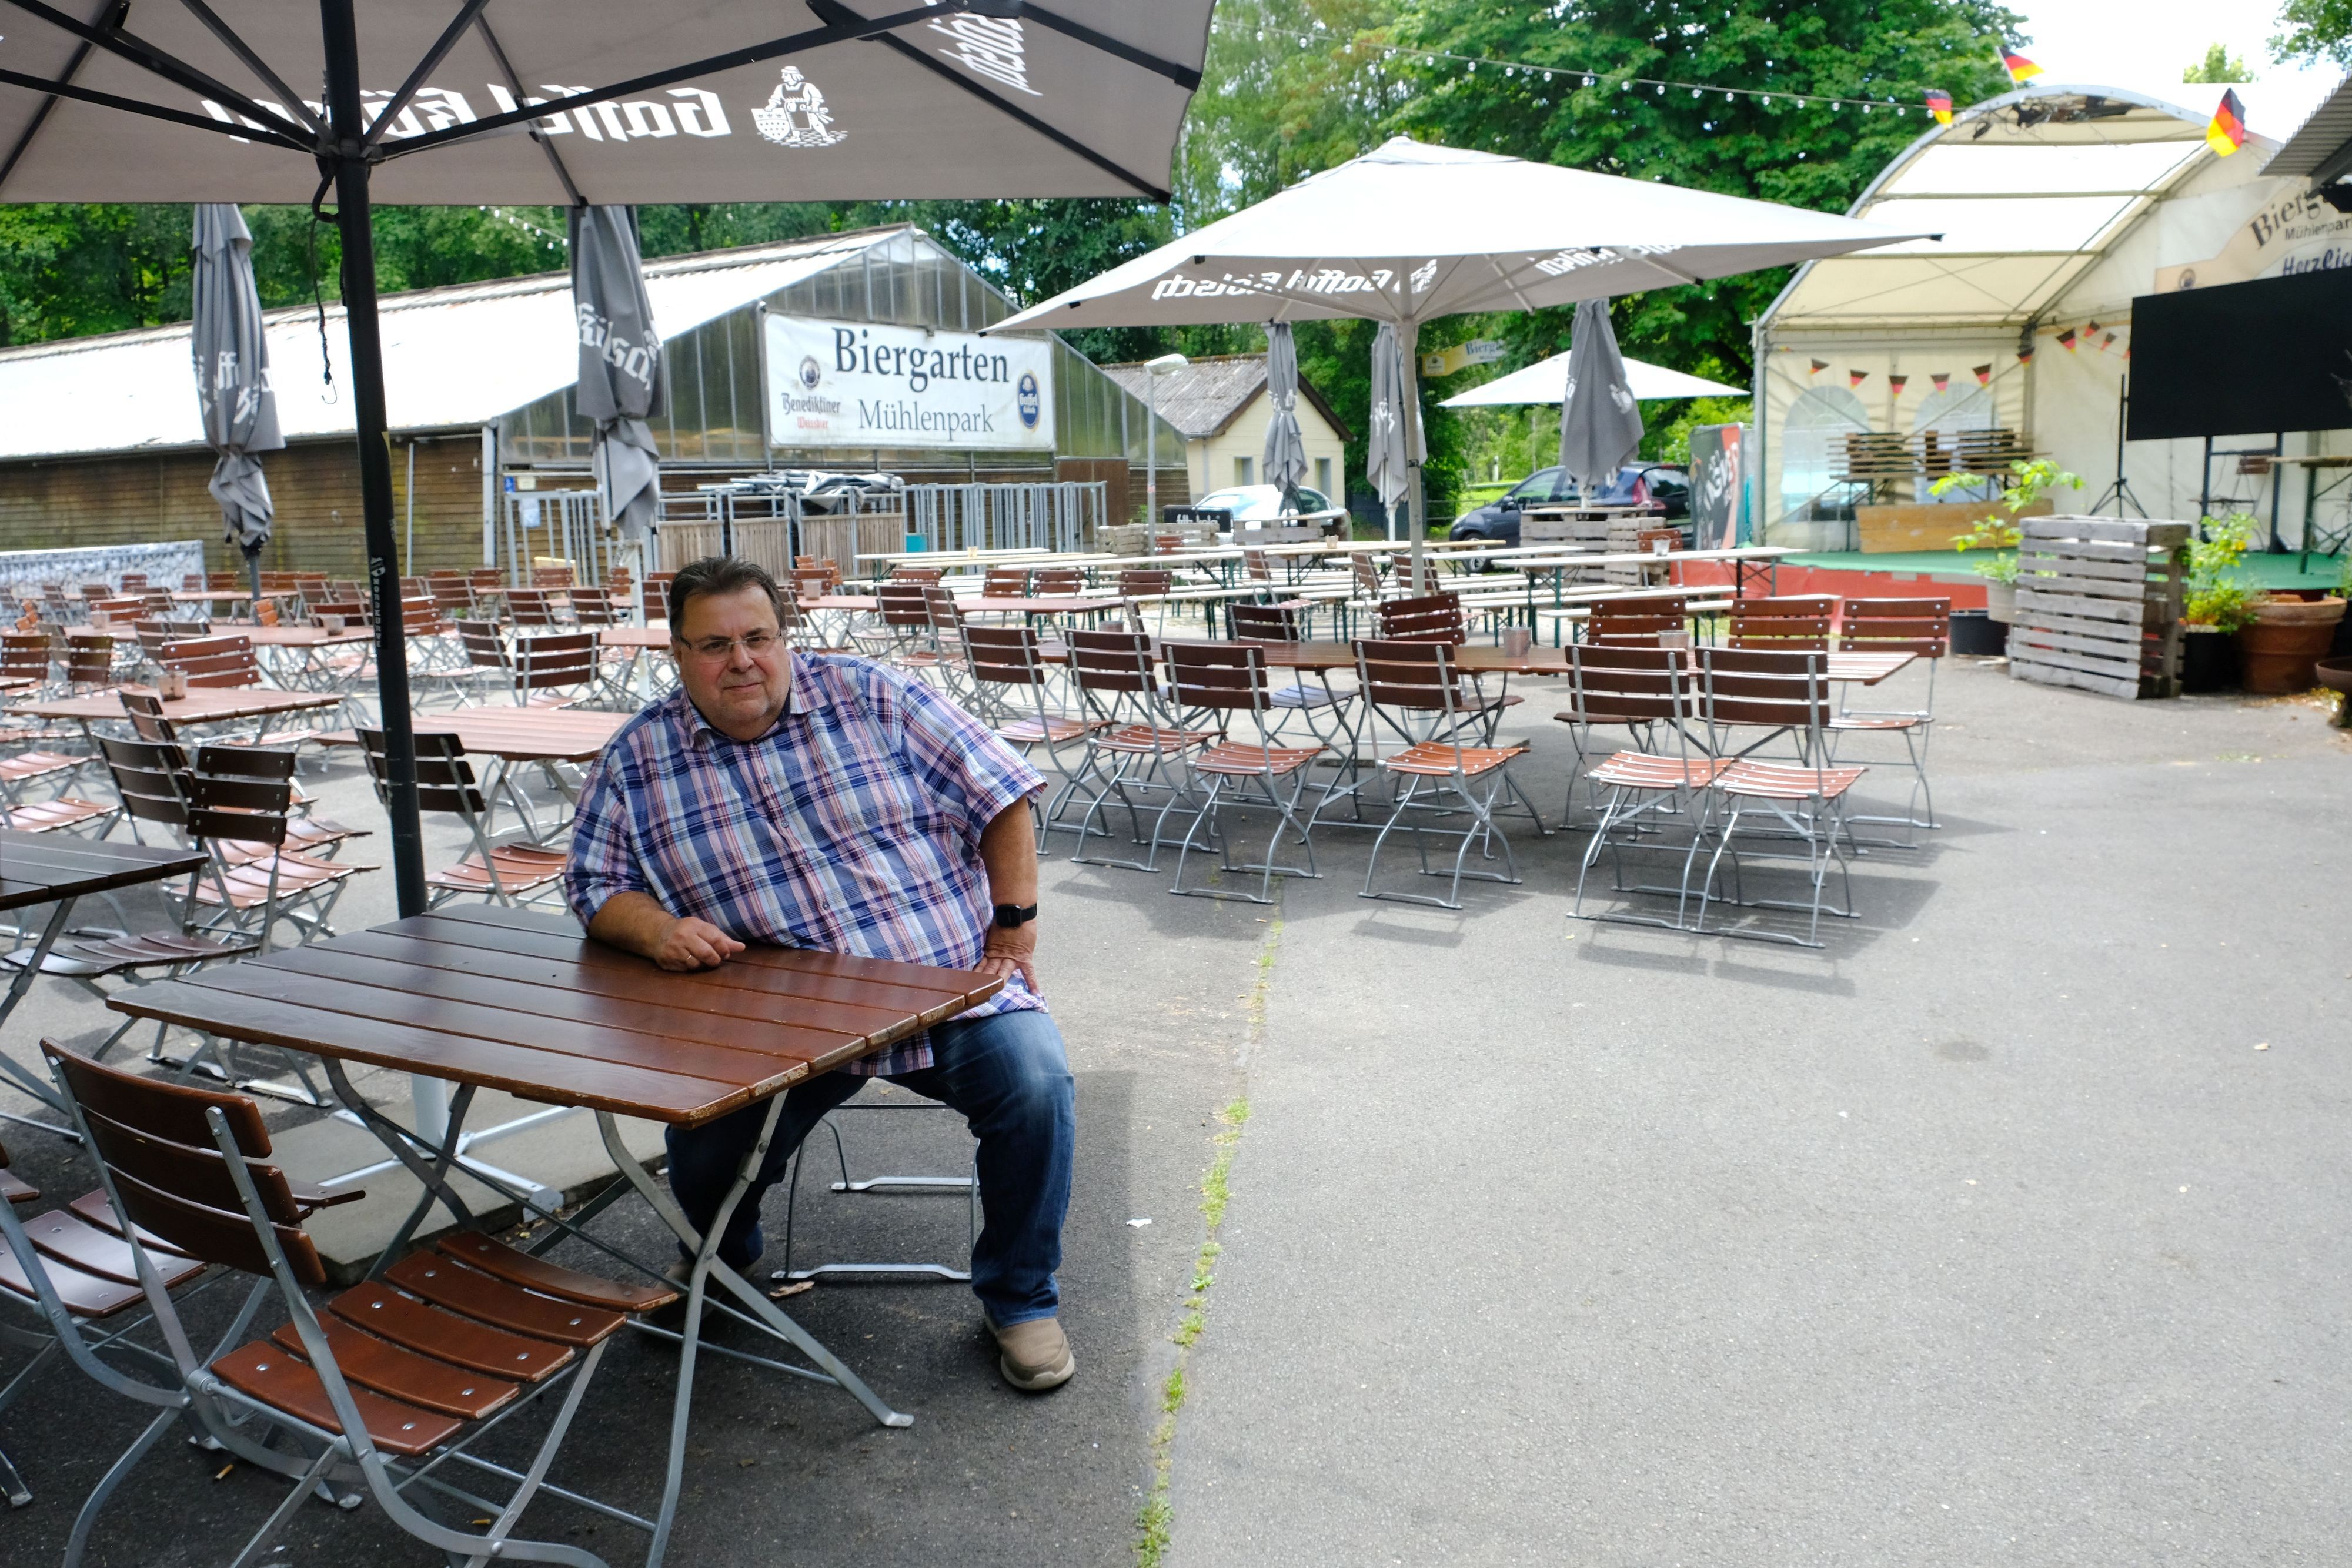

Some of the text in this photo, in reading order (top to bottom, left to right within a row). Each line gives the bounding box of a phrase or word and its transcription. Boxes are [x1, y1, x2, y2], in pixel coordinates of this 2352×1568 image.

[831, 327, 1009, 393] Biergarten
[781, 392, 841, 415] Benediktiner
[858, 399, 994, 441] Mühlenpark
